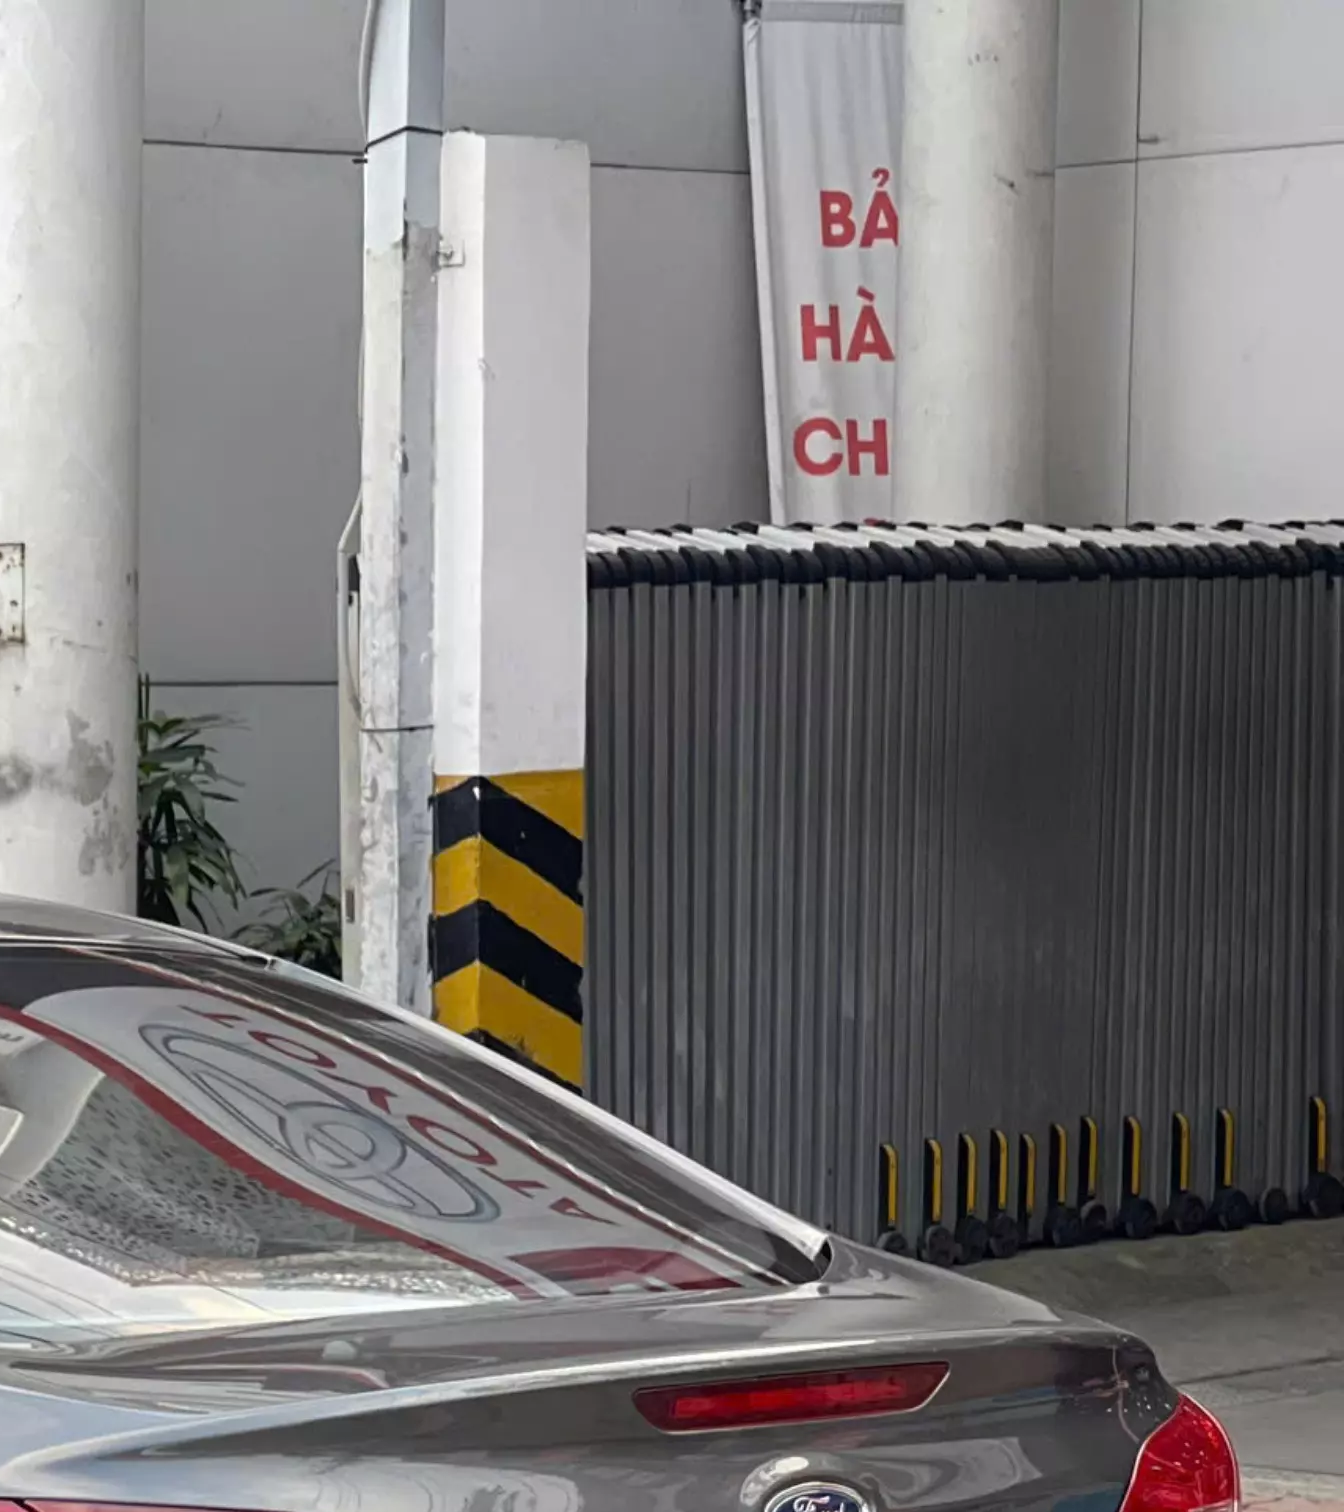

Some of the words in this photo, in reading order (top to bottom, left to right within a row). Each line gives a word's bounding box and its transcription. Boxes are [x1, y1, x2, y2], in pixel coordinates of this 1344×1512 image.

[820, 167, 900, 249] BẢ
[800, 285, 895, 363] HÀ
[793, 416, 891, 477] CH
